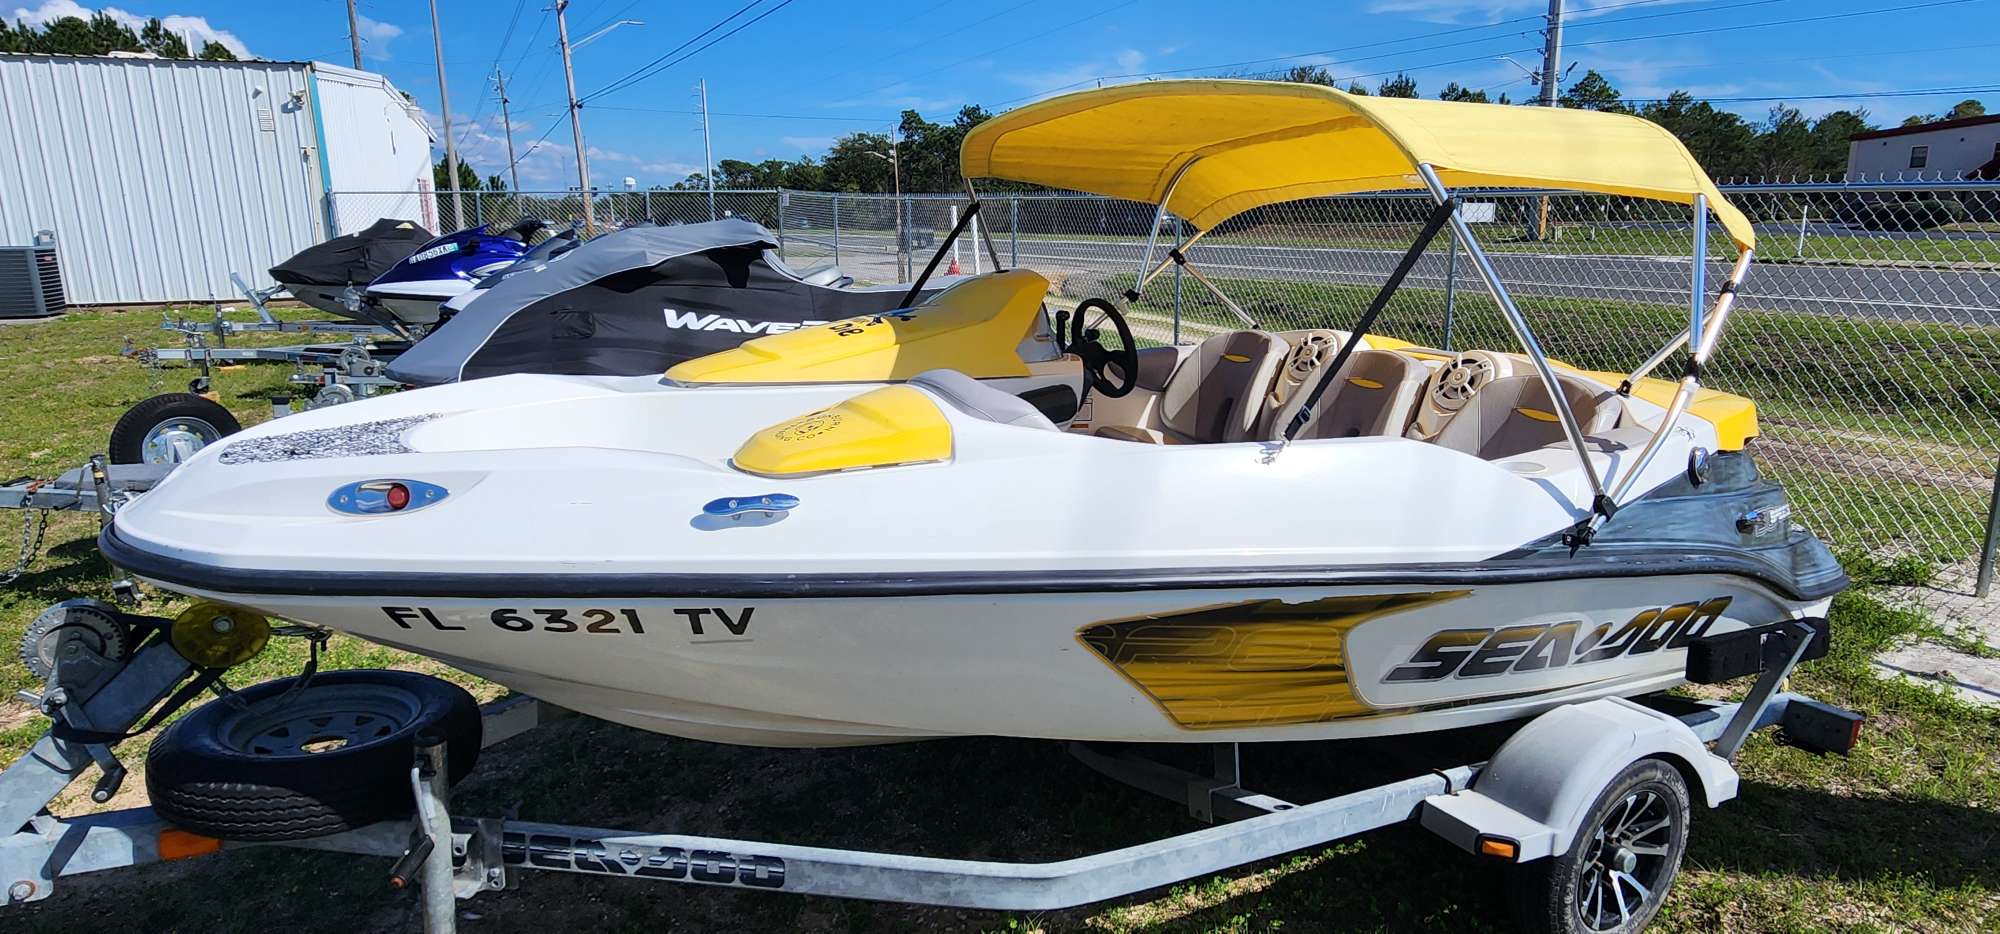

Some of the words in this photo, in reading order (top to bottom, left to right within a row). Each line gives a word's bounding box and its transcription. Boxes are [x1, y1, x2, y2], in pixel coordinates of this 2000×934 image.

[381, 606, 467, 631] FL
[490, 608, 645, 634] 6321
[673, 607, 755, 636] TV
